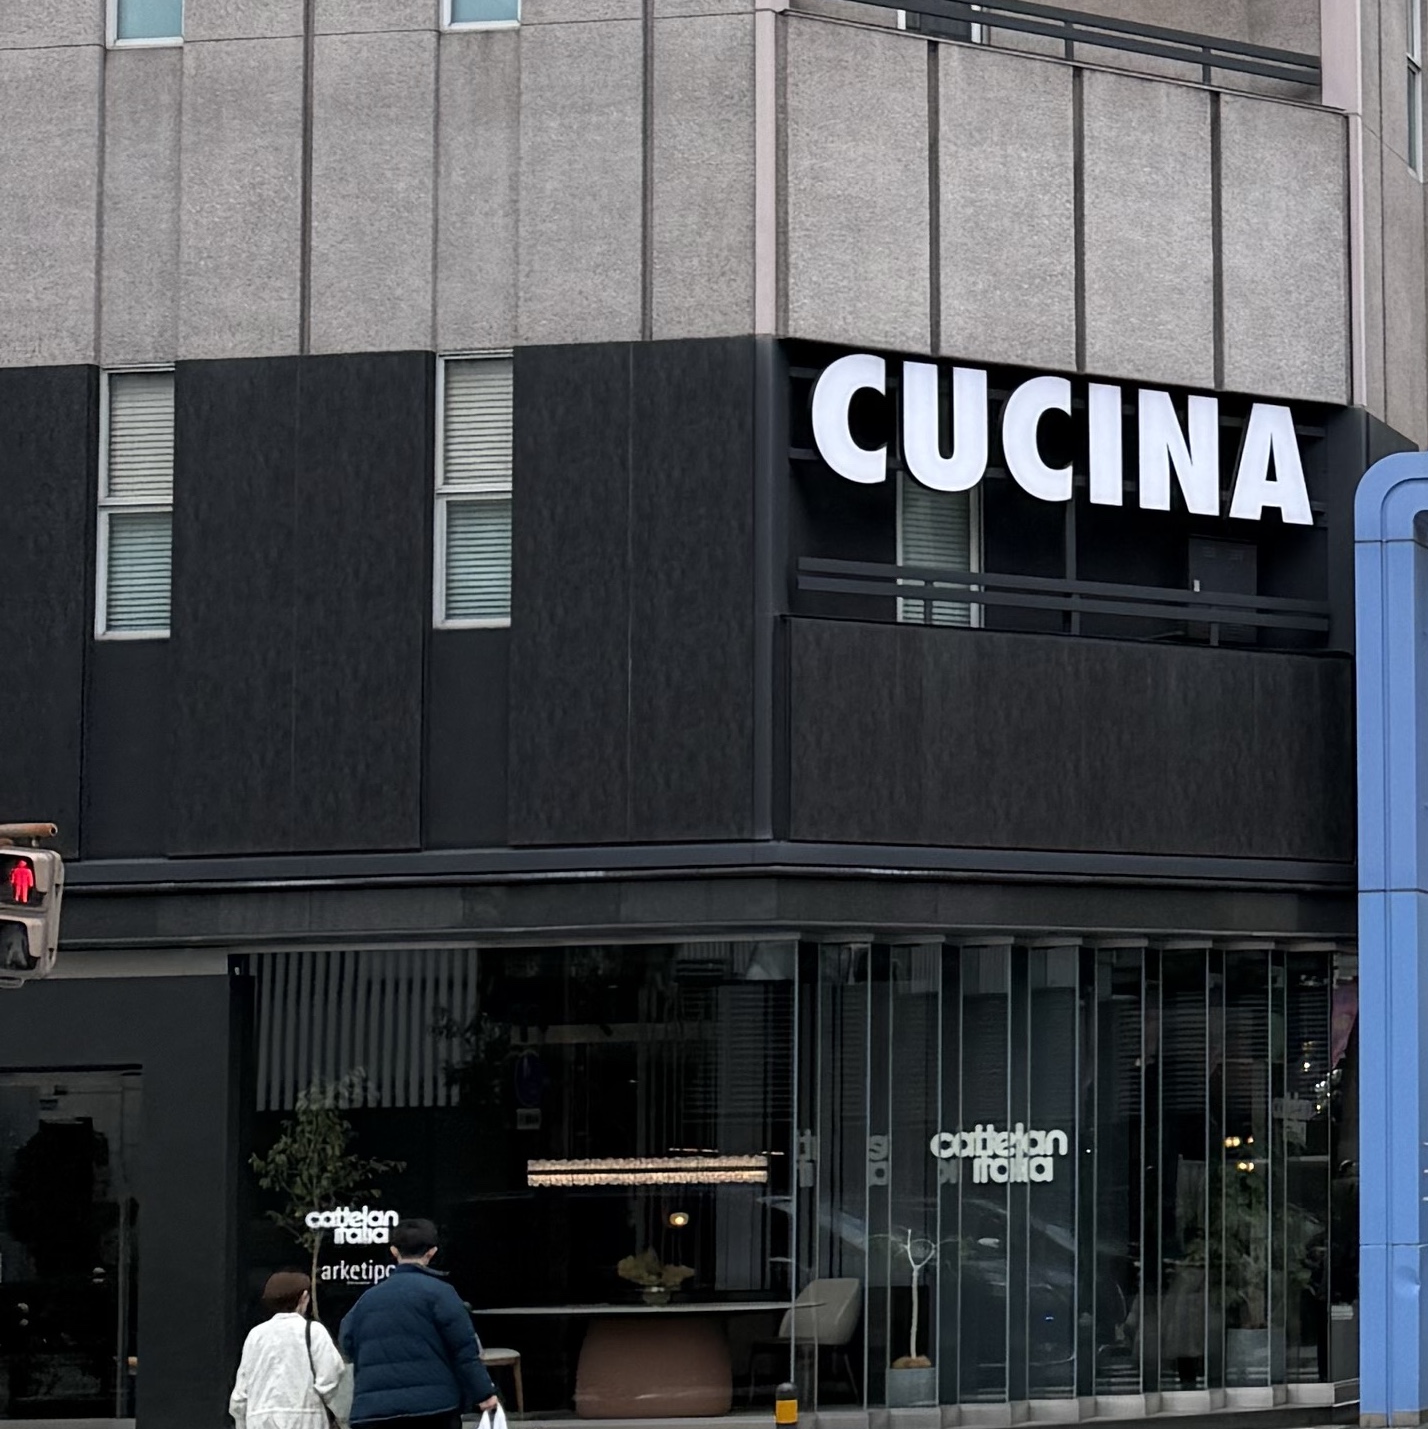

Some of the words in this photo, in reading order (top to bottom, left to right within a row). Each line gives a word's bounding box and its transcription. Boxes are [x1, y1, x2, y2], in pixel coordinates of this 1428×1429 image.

[811, 353, 1314, 525] CUCINA
[930, 1122, 1068, 1159] cattelan
[972, 1156, 1053, 1184] italia
[305, 1205, 399, 1228] cattelan
